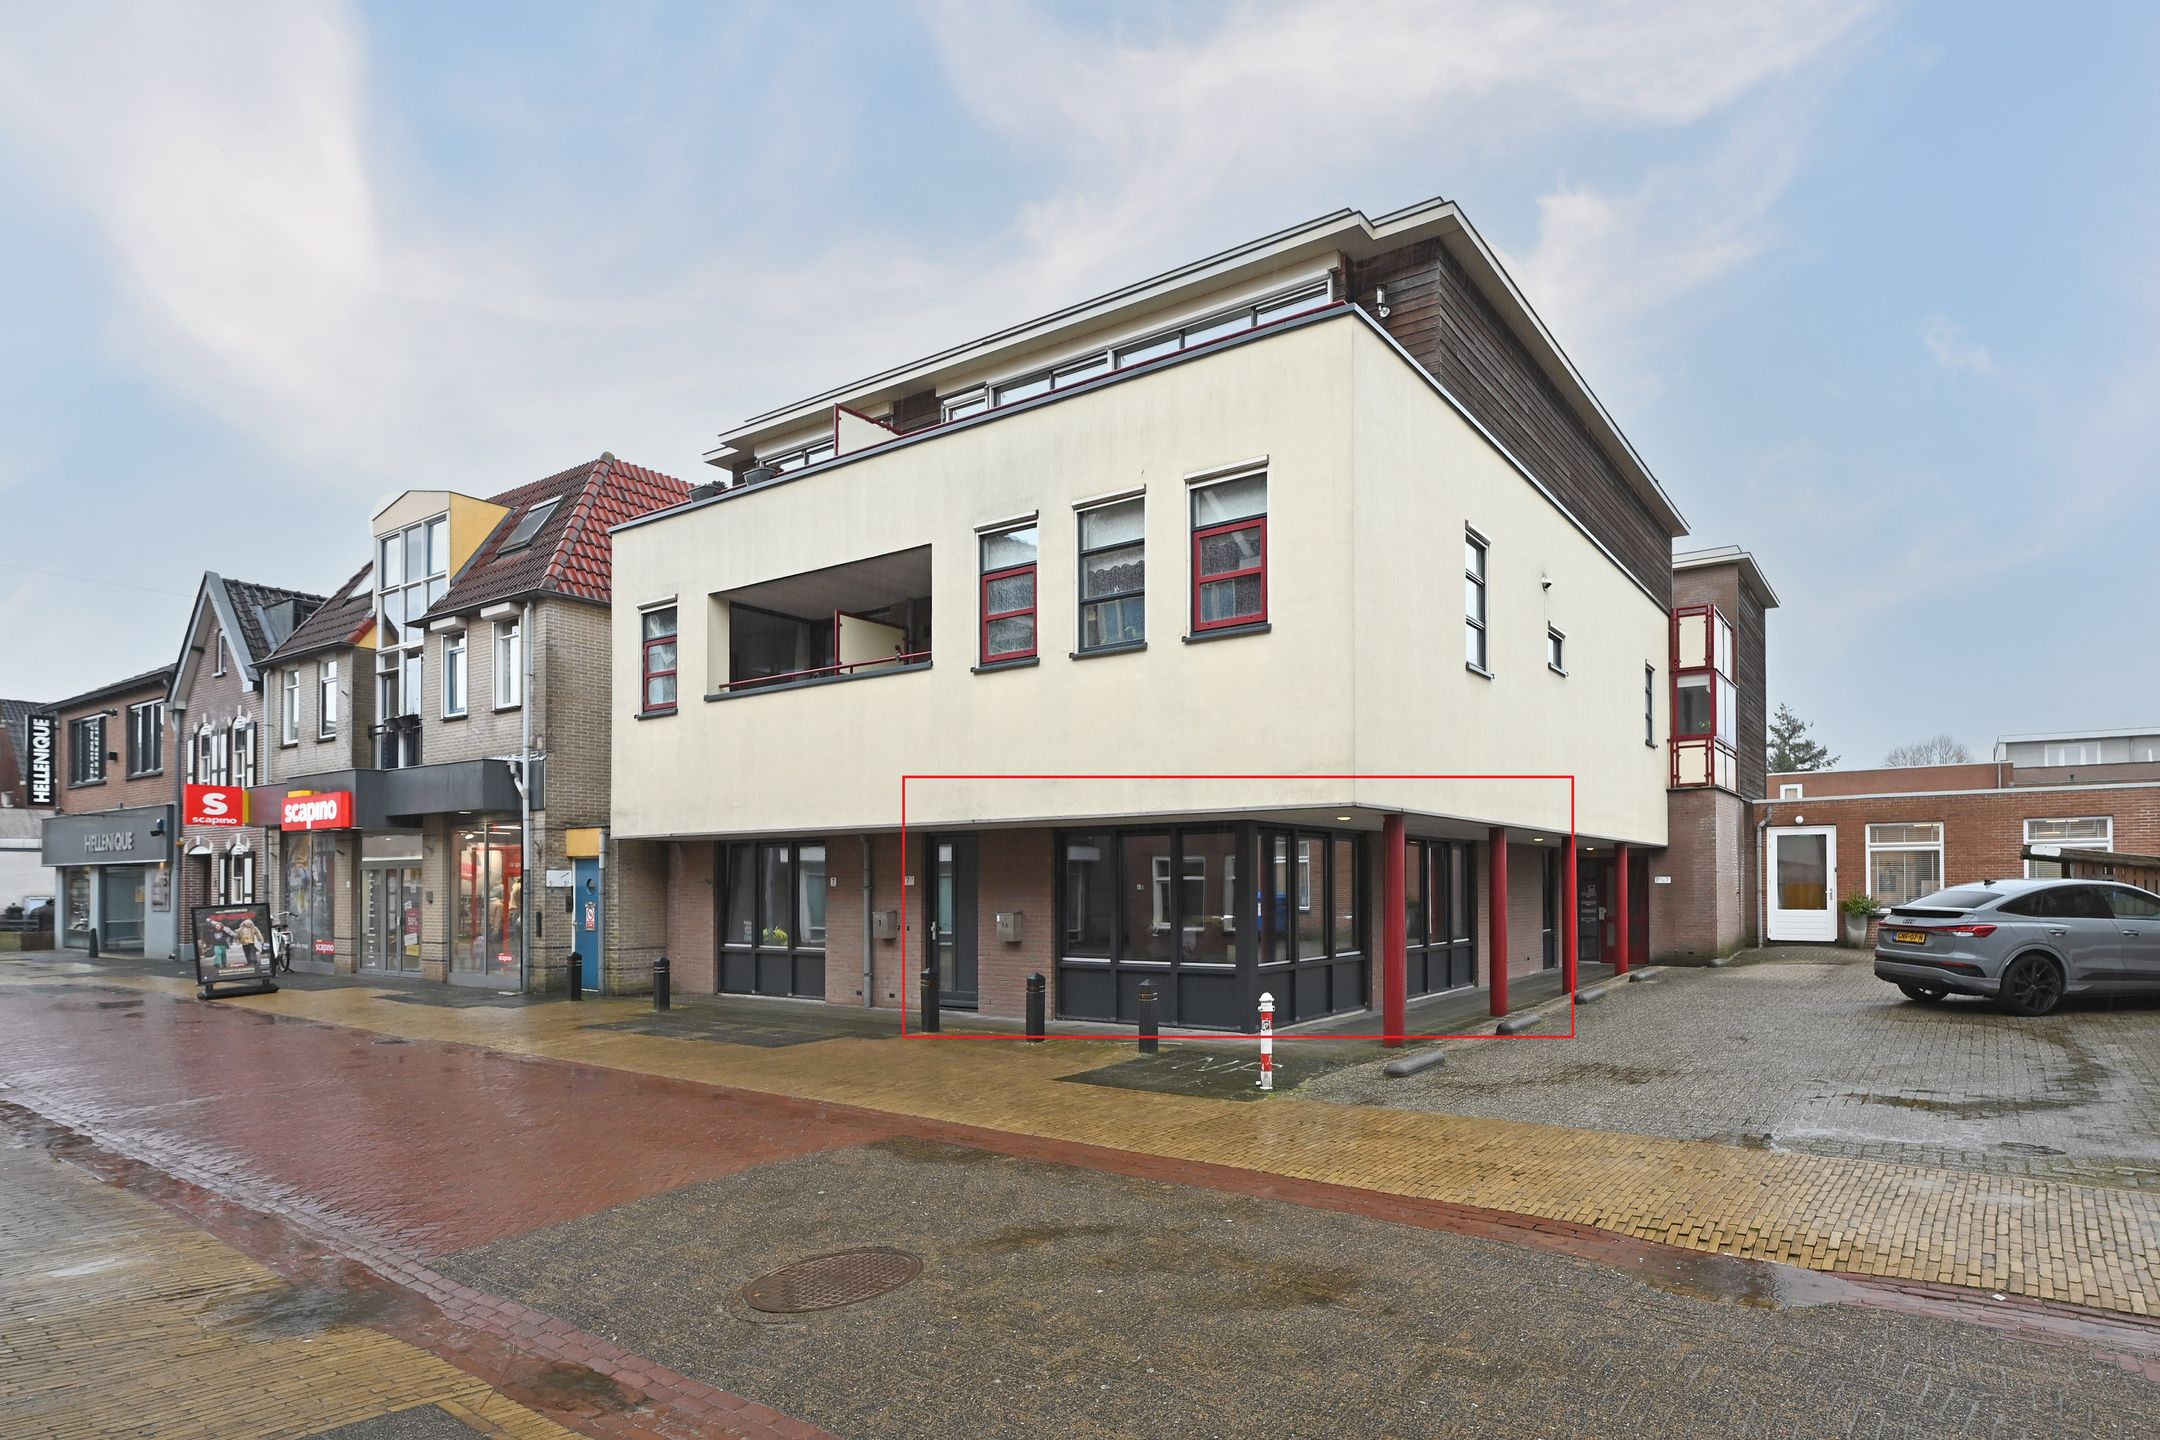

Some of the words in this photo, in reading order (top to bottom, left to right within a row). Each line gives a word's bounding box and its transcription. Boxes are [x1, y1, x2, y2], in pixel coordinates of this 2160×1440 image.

[33, 718, 50, 803] HELLENIQUE
[202, 792, 228, 815] S
[284, 799, 338, 829] scapino
[192, 816, 237, 825] scapino
[84, 832, 133, 852] HELLENIQUE
